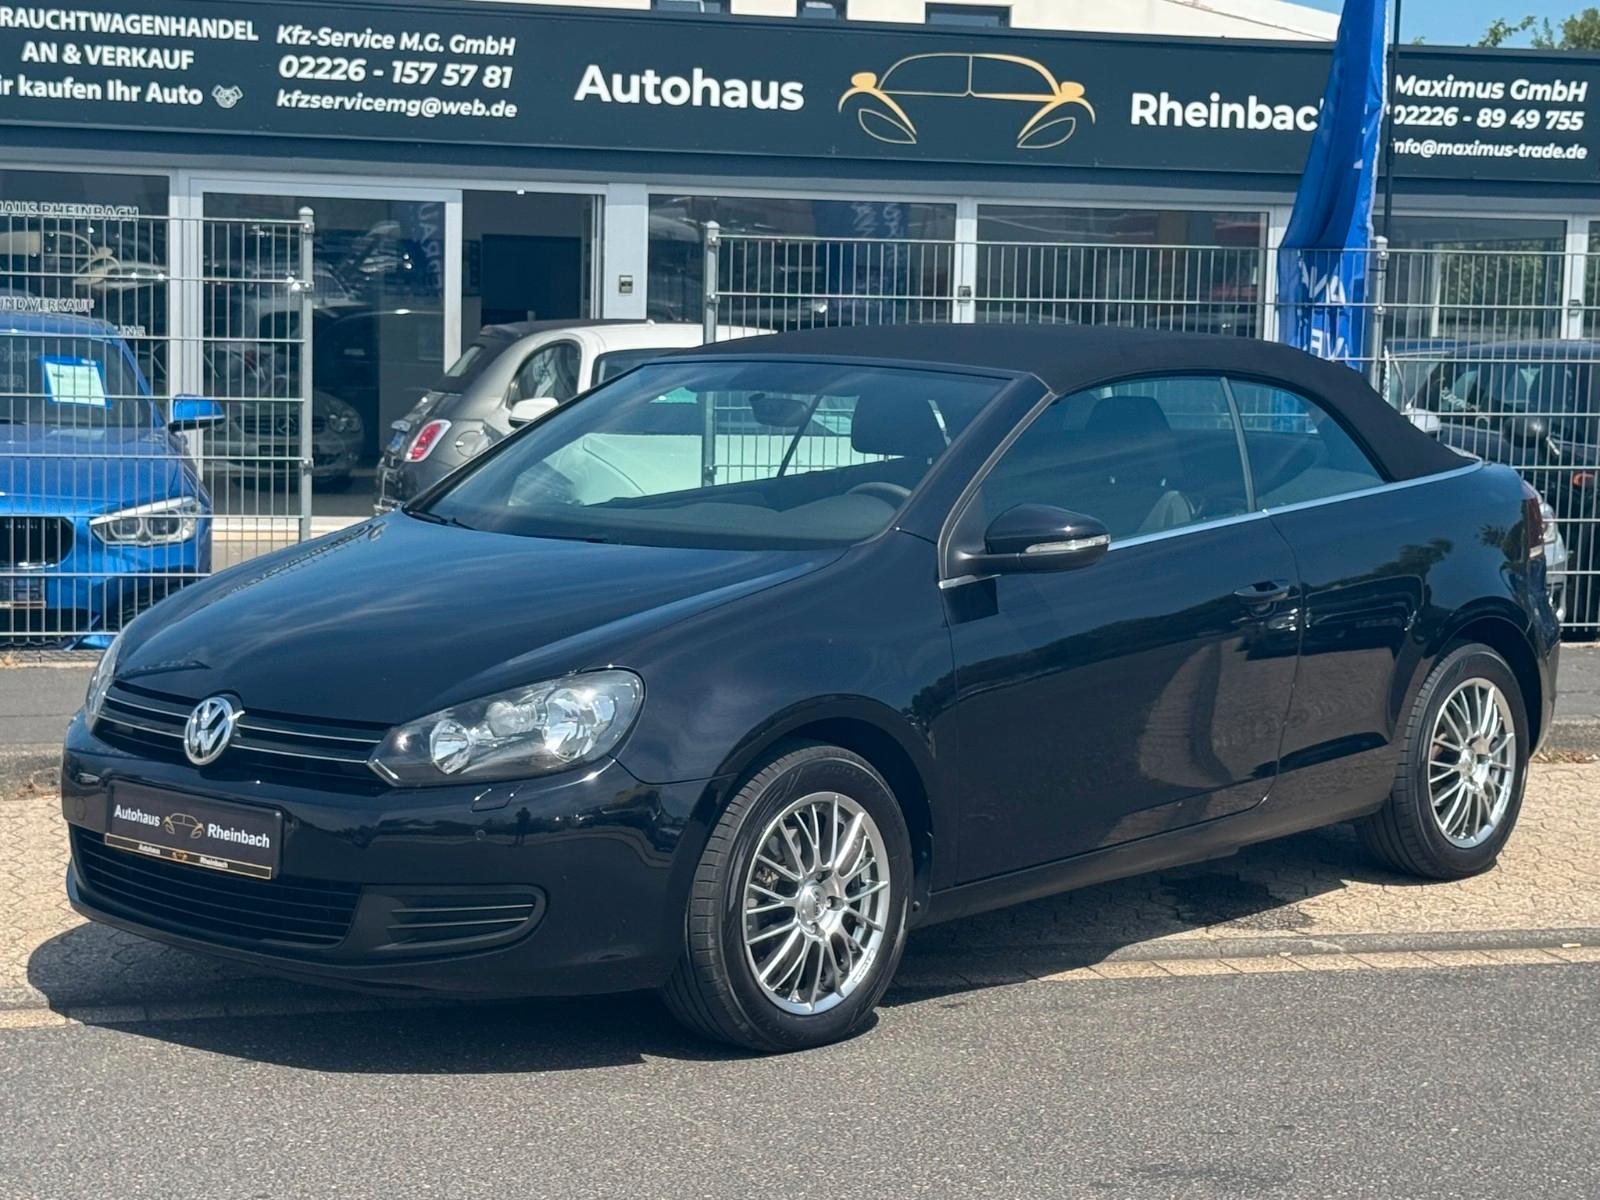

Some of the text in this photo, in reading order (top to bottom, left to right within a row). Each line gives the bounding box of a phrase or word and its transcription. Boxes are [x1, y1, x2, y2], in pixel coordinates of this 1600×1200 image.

[0, 6, 259, 42] RAUCHTWAGENHANDEL
[21, 41, 195, 70] AN & VERKAUF
[276, 24, 516, 56] Kfz-Service M.G. GmbH
[278, 54, 367, 82] 02226
[391, 60, 438, 85] 157
[441, 63, 478, 88] 57
[482, 65, 513, 89] 81
[17, 74, 102, 101] kaufen
[107, 80, 141, 102] Ihr
[145, 82, 203, 105] Auto
[276, 89, 518, 118] kfzservicemg@web.de
[573, 64, 1324, 132] Autohaus Rheinbac
[1395, 74, 1588, 102] Maximus GmbH
[1386, 104, 1459, 127] 02226
[1476, 107, 1506, 129] 89
[1510, 109, 1540, 130] 49
[1545, 110, 1585, 131] 755
[114, 804, 270, 849] Autohaus Rheinbach
